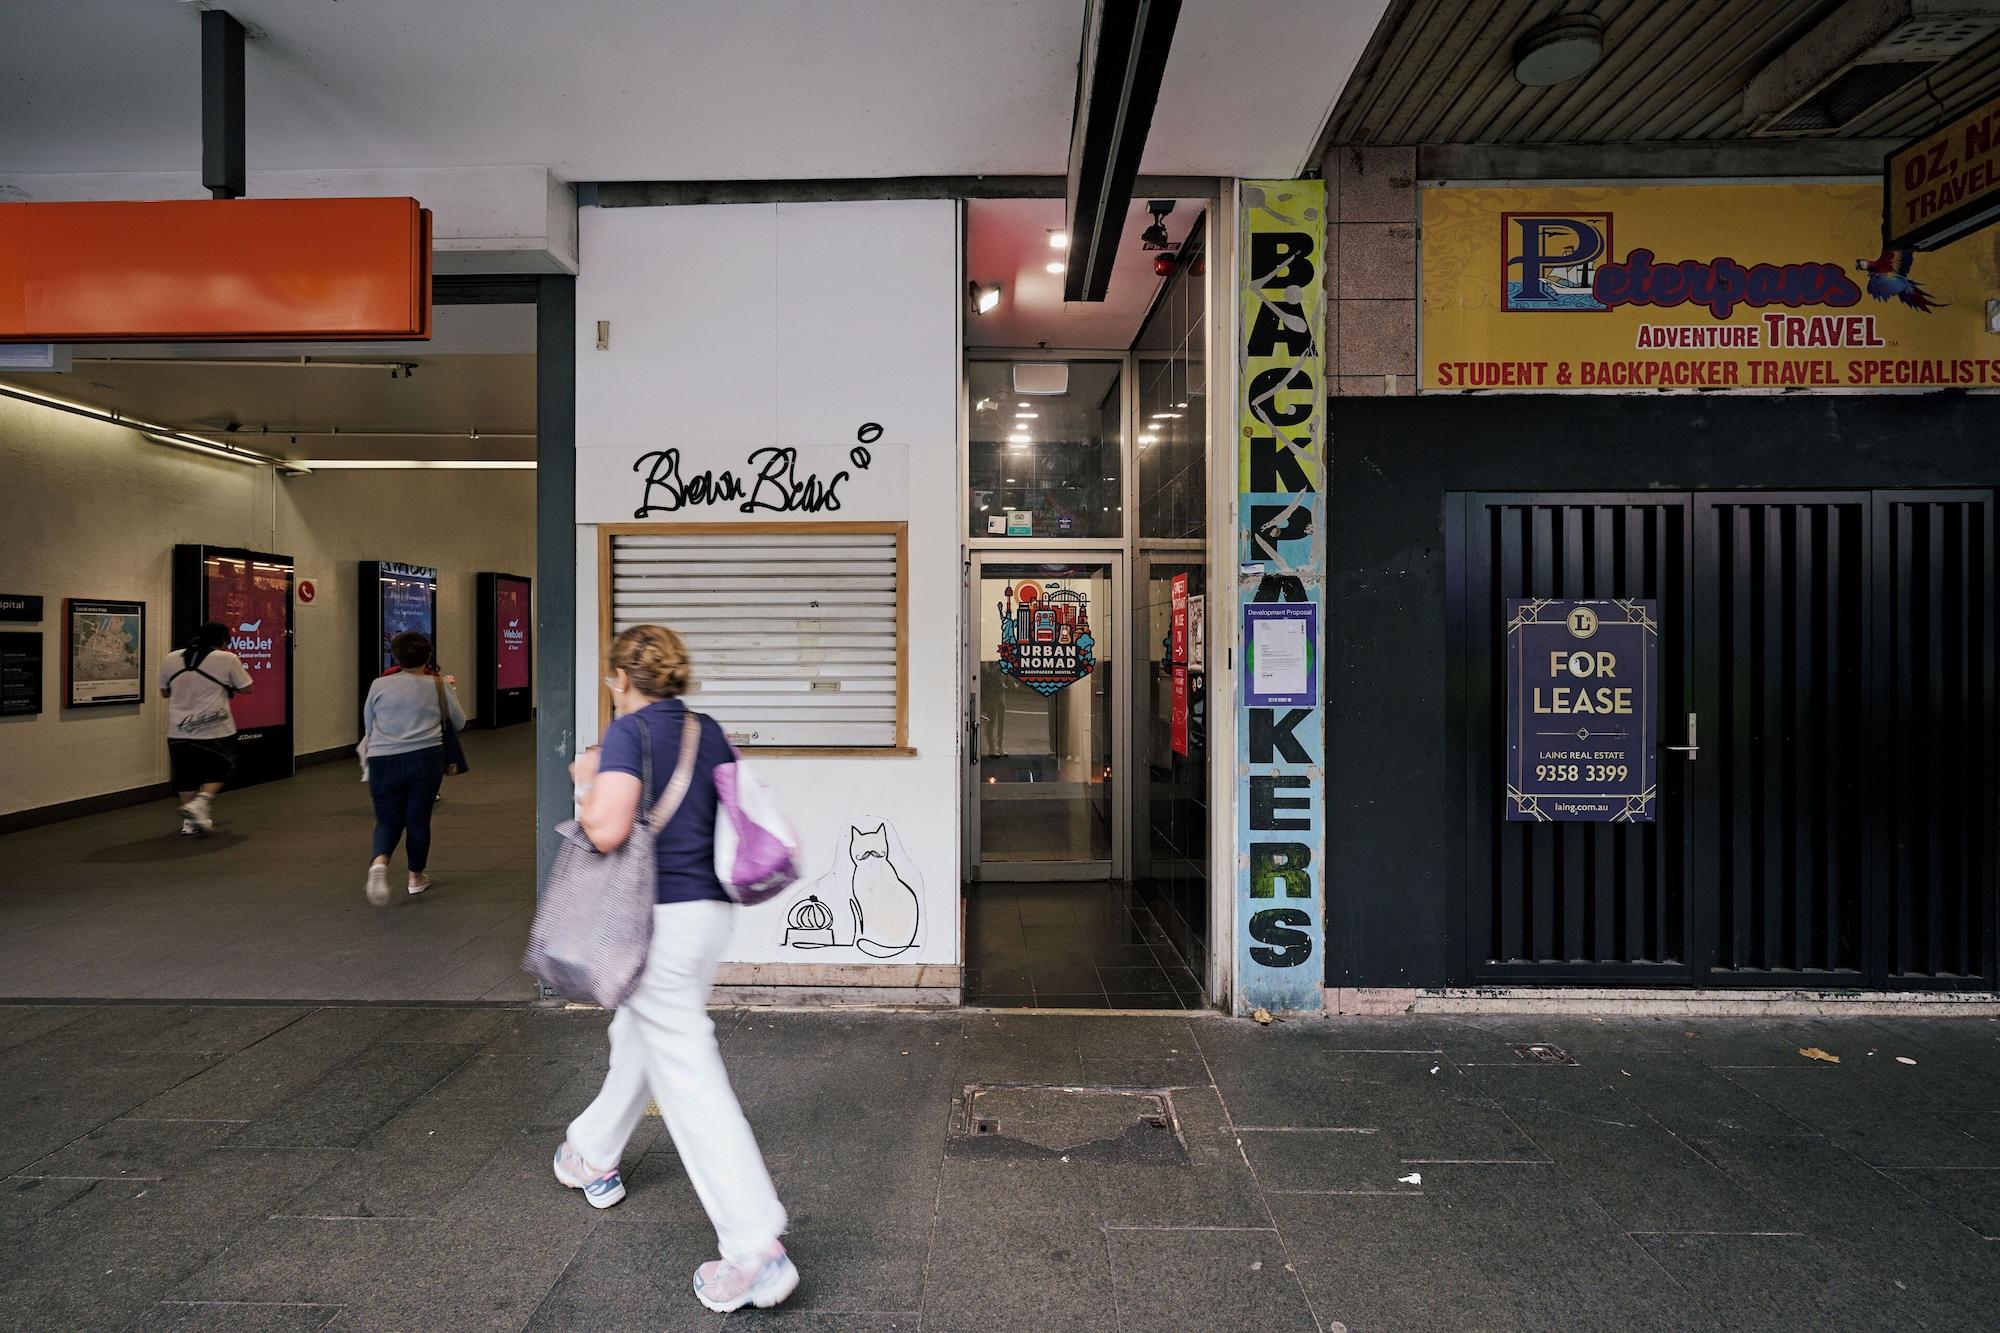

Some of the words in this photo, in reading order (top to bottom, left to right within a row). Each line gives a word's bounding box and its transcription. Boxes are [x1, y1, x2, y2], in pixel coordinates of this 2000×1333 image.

[1904, 139, 1958, 191] OZ,
[1507, 218, 1861, 319] Peterpans
[1637, 325, 1759, 348] ADVENTURE
[1763, 313, 1884, 347] TRAVEL
[1438, 362, 1547, 386] STUDENT
[1556, 361, 1572, 386] &
[1581, 360, 1739, 385] BACKPACKER
[1747, 360, 1839, 385] TRAVEL
[1848, 360, 2000, 384] SPECIALISTS
[1020, 645, 1076, 656] URBAN
[1020, 657, 1076, 668] NOMAD
[1550, 650, 1616, 678] FOR
[1533, 687, 1632, 714] LEASE
[1539, 751, 1567, 760] LAING
[1570, 751, 1592, 760] REAL
[1594, 751, 1624, 760] ESTATE
[1536, 765, 1579, 782] 9358
[1585, 765, 1628, 782] 3399
[1555, 802, 1608, 813] laing.com.au
